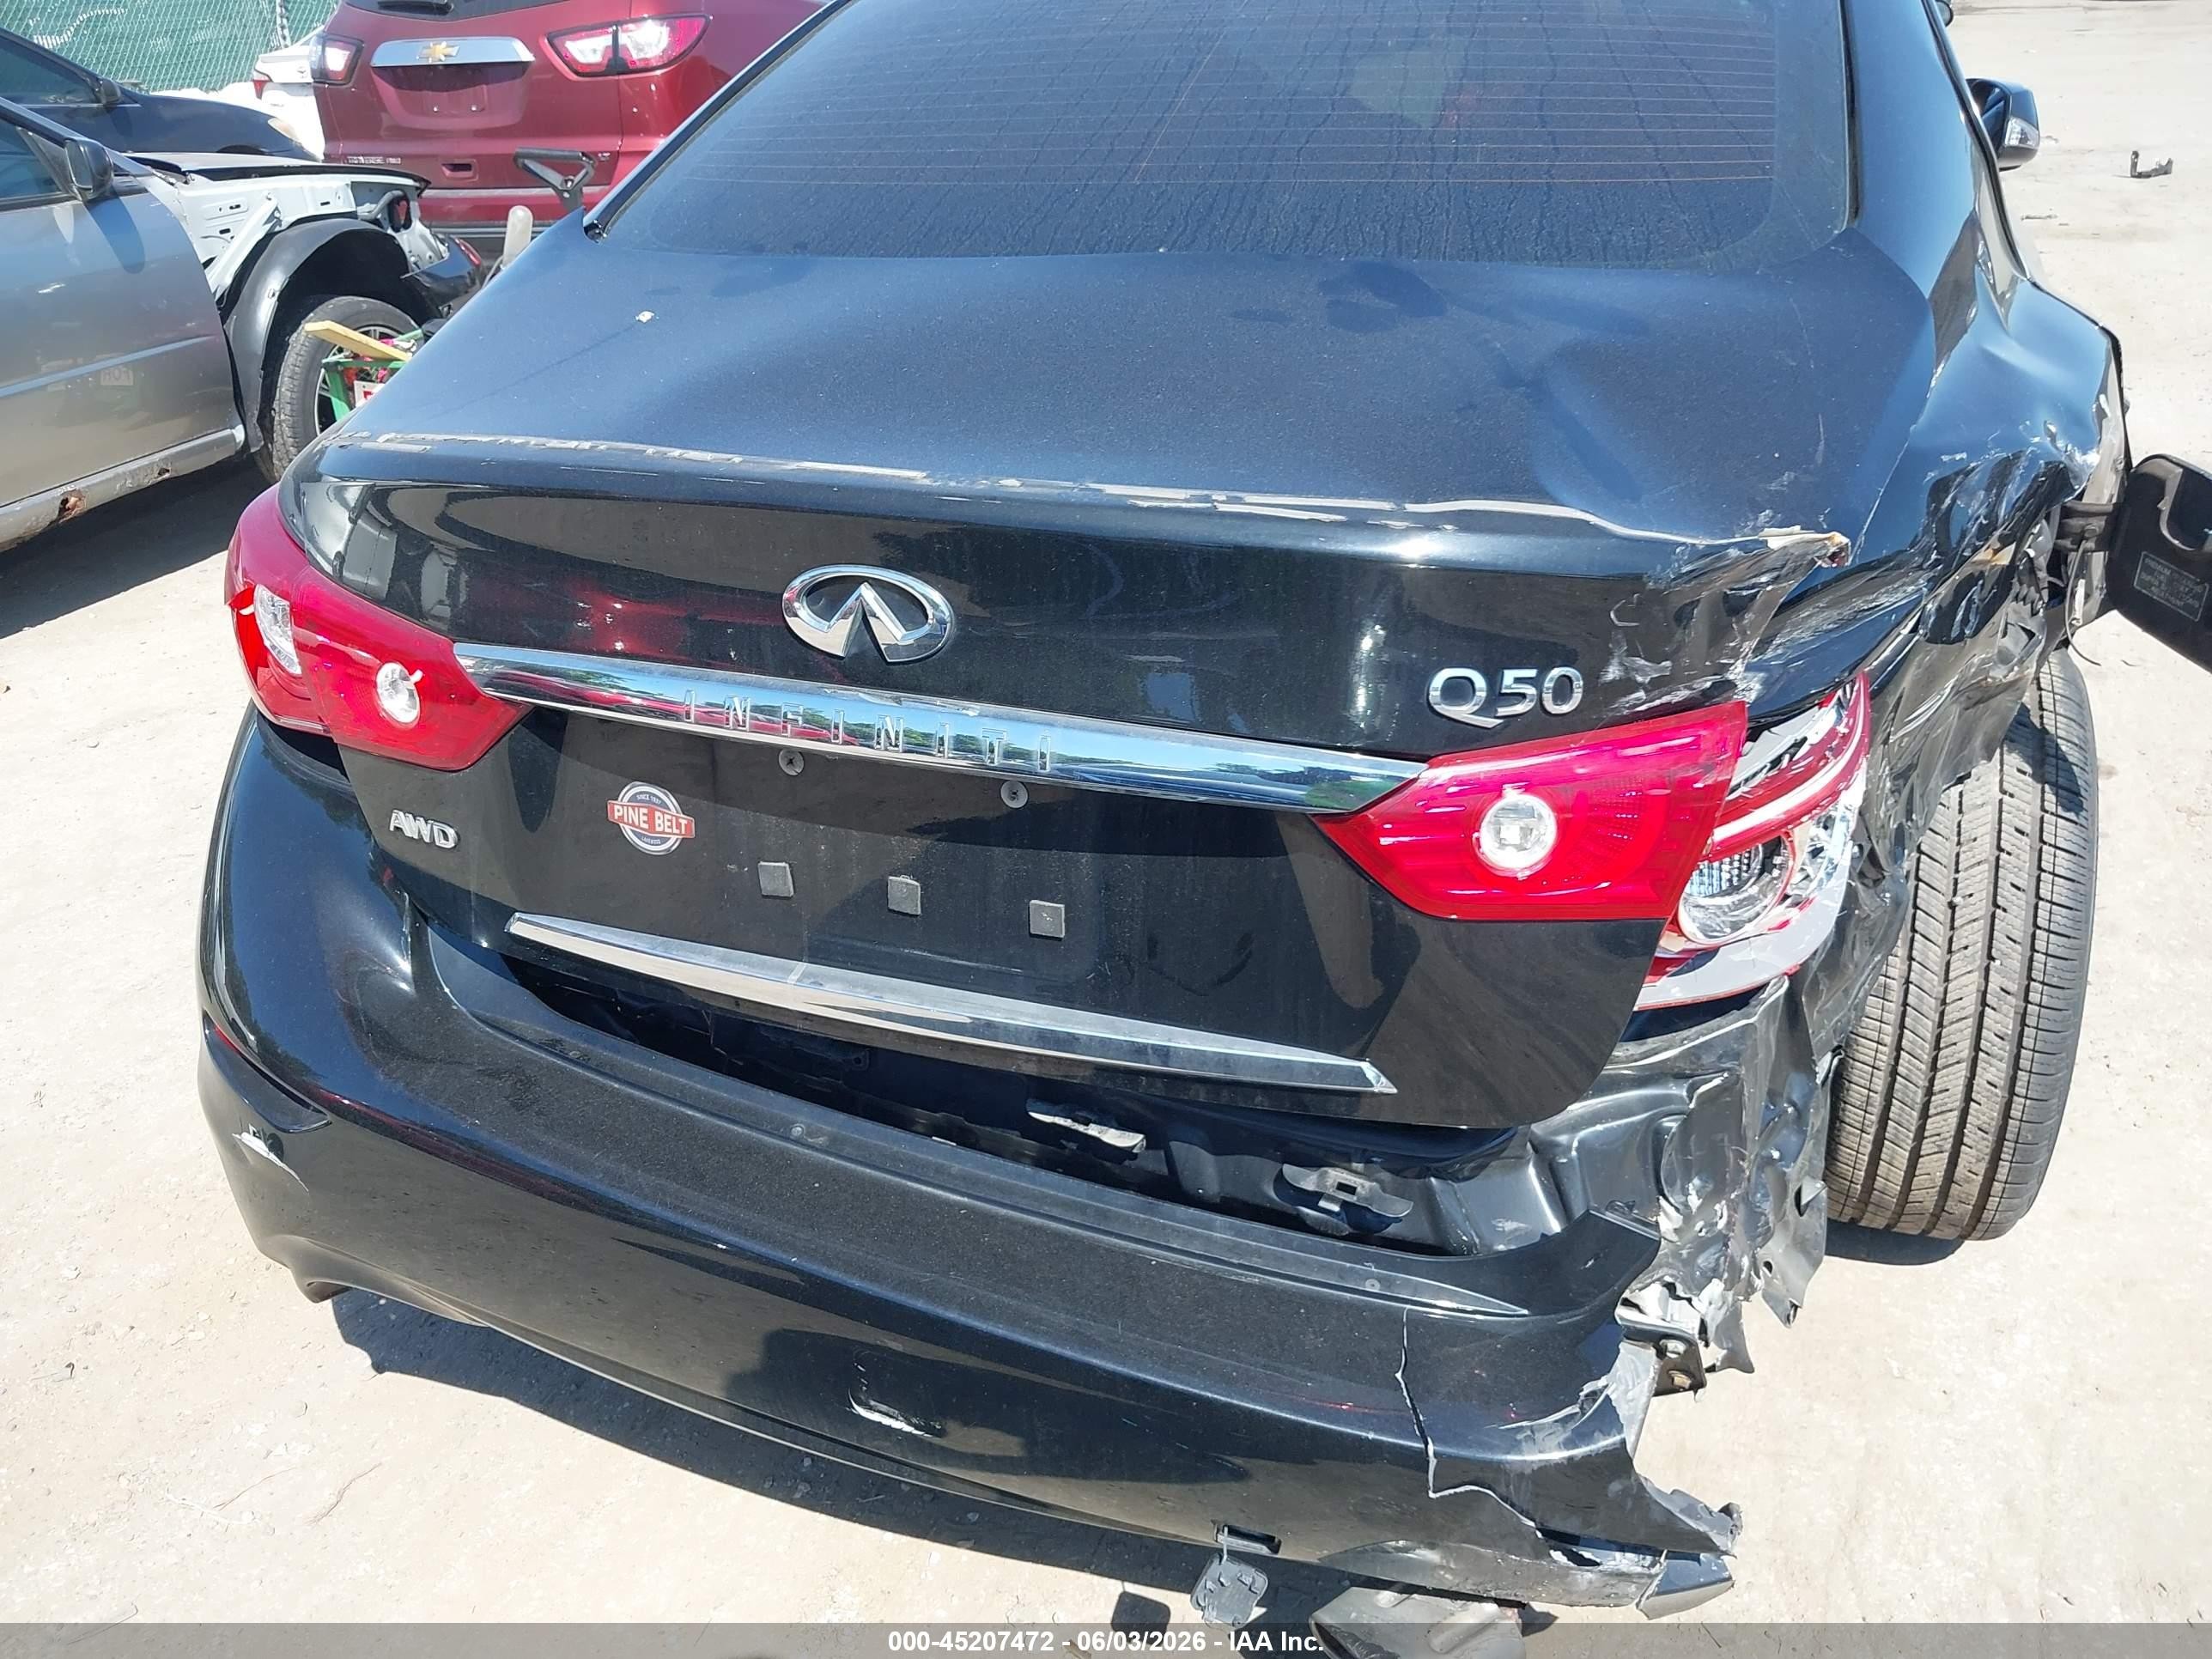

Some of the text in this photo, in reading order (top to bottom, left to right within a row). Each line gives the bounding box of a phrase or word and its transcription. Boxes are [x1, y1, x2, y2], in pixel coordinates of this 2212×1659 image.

[1428, 667, 1583, 729] Q50
[684, 688, 1051, 772] INFINITI
[389, 809, 459, 849] AWD
[614, 805, 688, 835] PINE BELT
